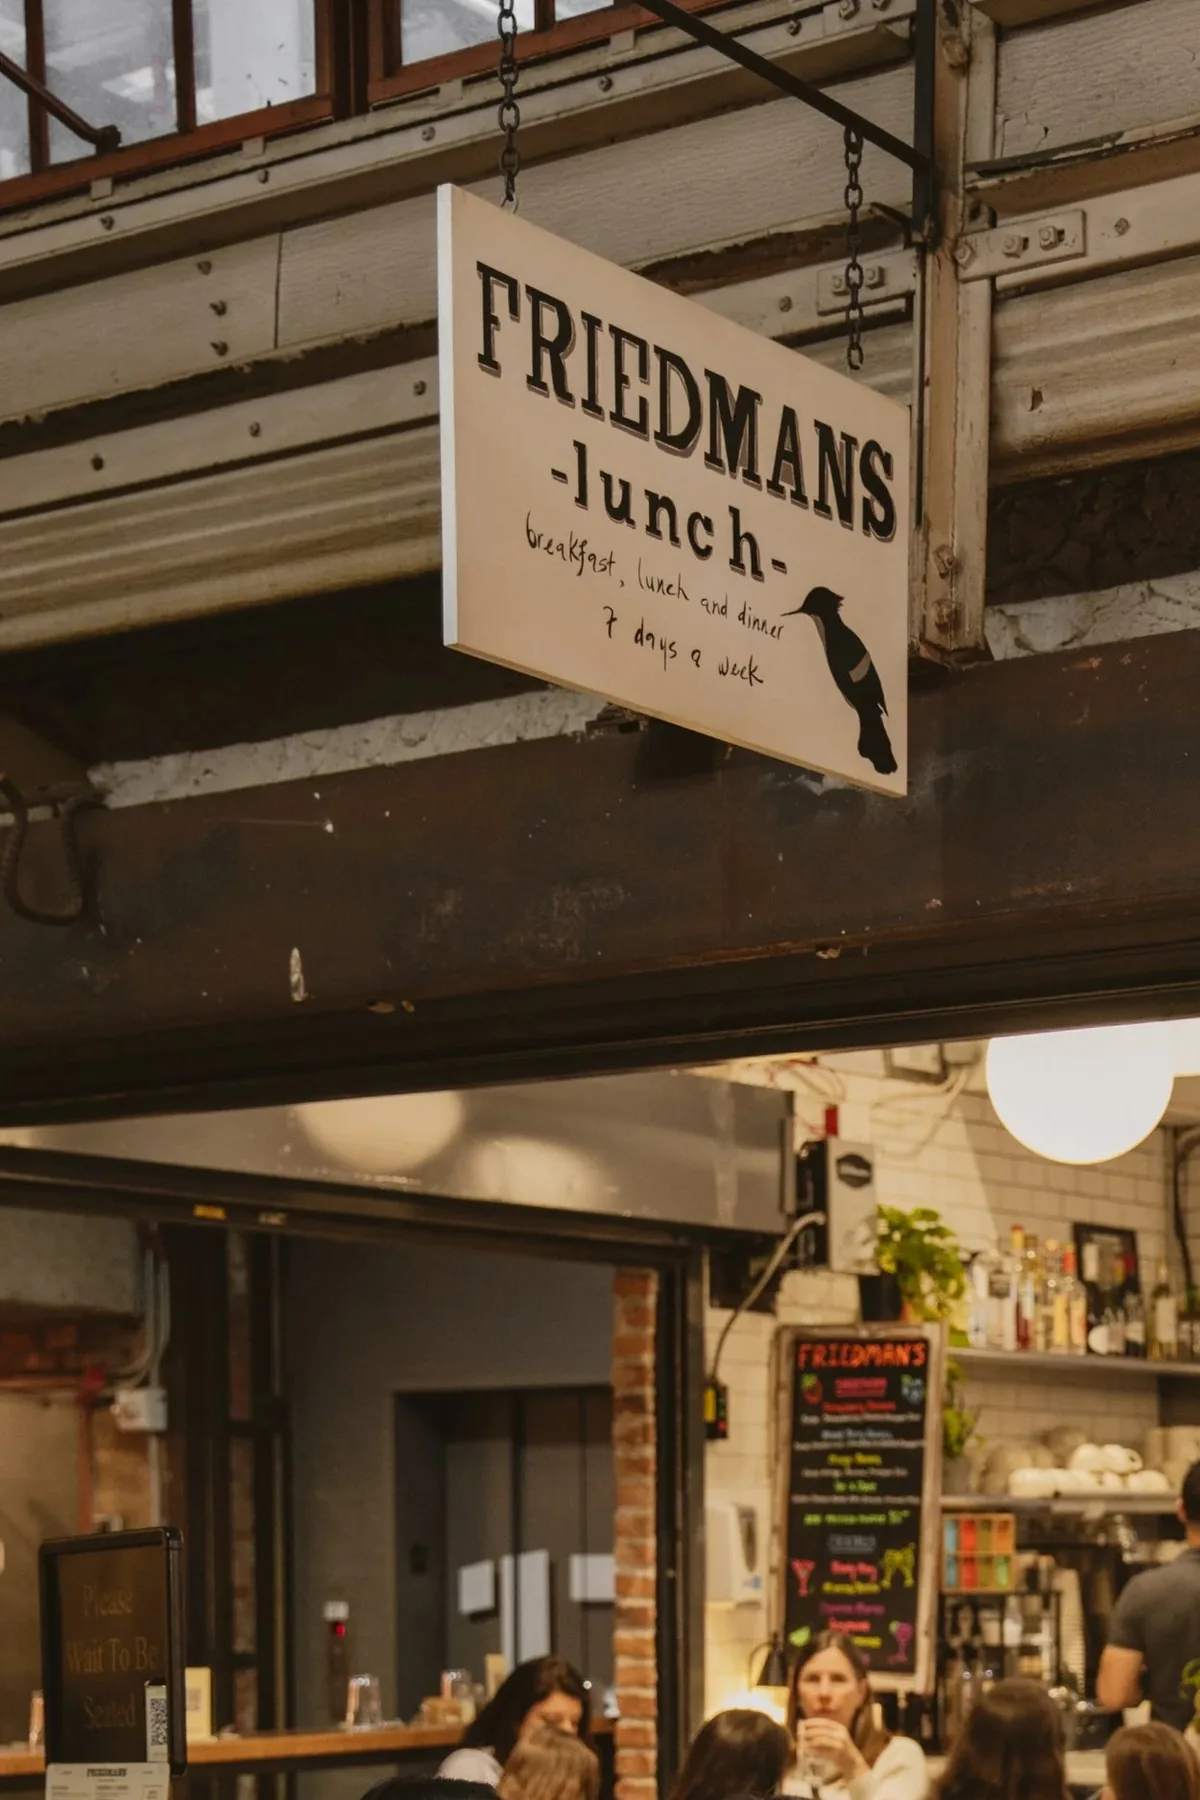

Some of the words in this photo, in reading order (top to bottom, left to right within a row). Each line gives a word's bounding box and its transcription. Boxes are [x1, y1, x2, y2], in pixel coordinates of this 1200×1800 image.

[475, 260, 898, 544] FRIEDMANS
[525, 510, 626, 588] breakfast,
[637, 557, 690, 601] lunch
[700, 594, 728, 619] and
[737, 604, 785, 641] dinner
[602, 605, 618, 639] 7
[634, 617, 678, 671] days
[690, 649, 702, 668] a
[718, 655, 764, 687] week
[83, 1584, 134, 1617] Please
[67, 1638, 104, 1673] Wait
[108, 1638, 130, 1672] To
[135, 1635, 158, 1671] Be
[83, 1692, 137, 1730] Seated
